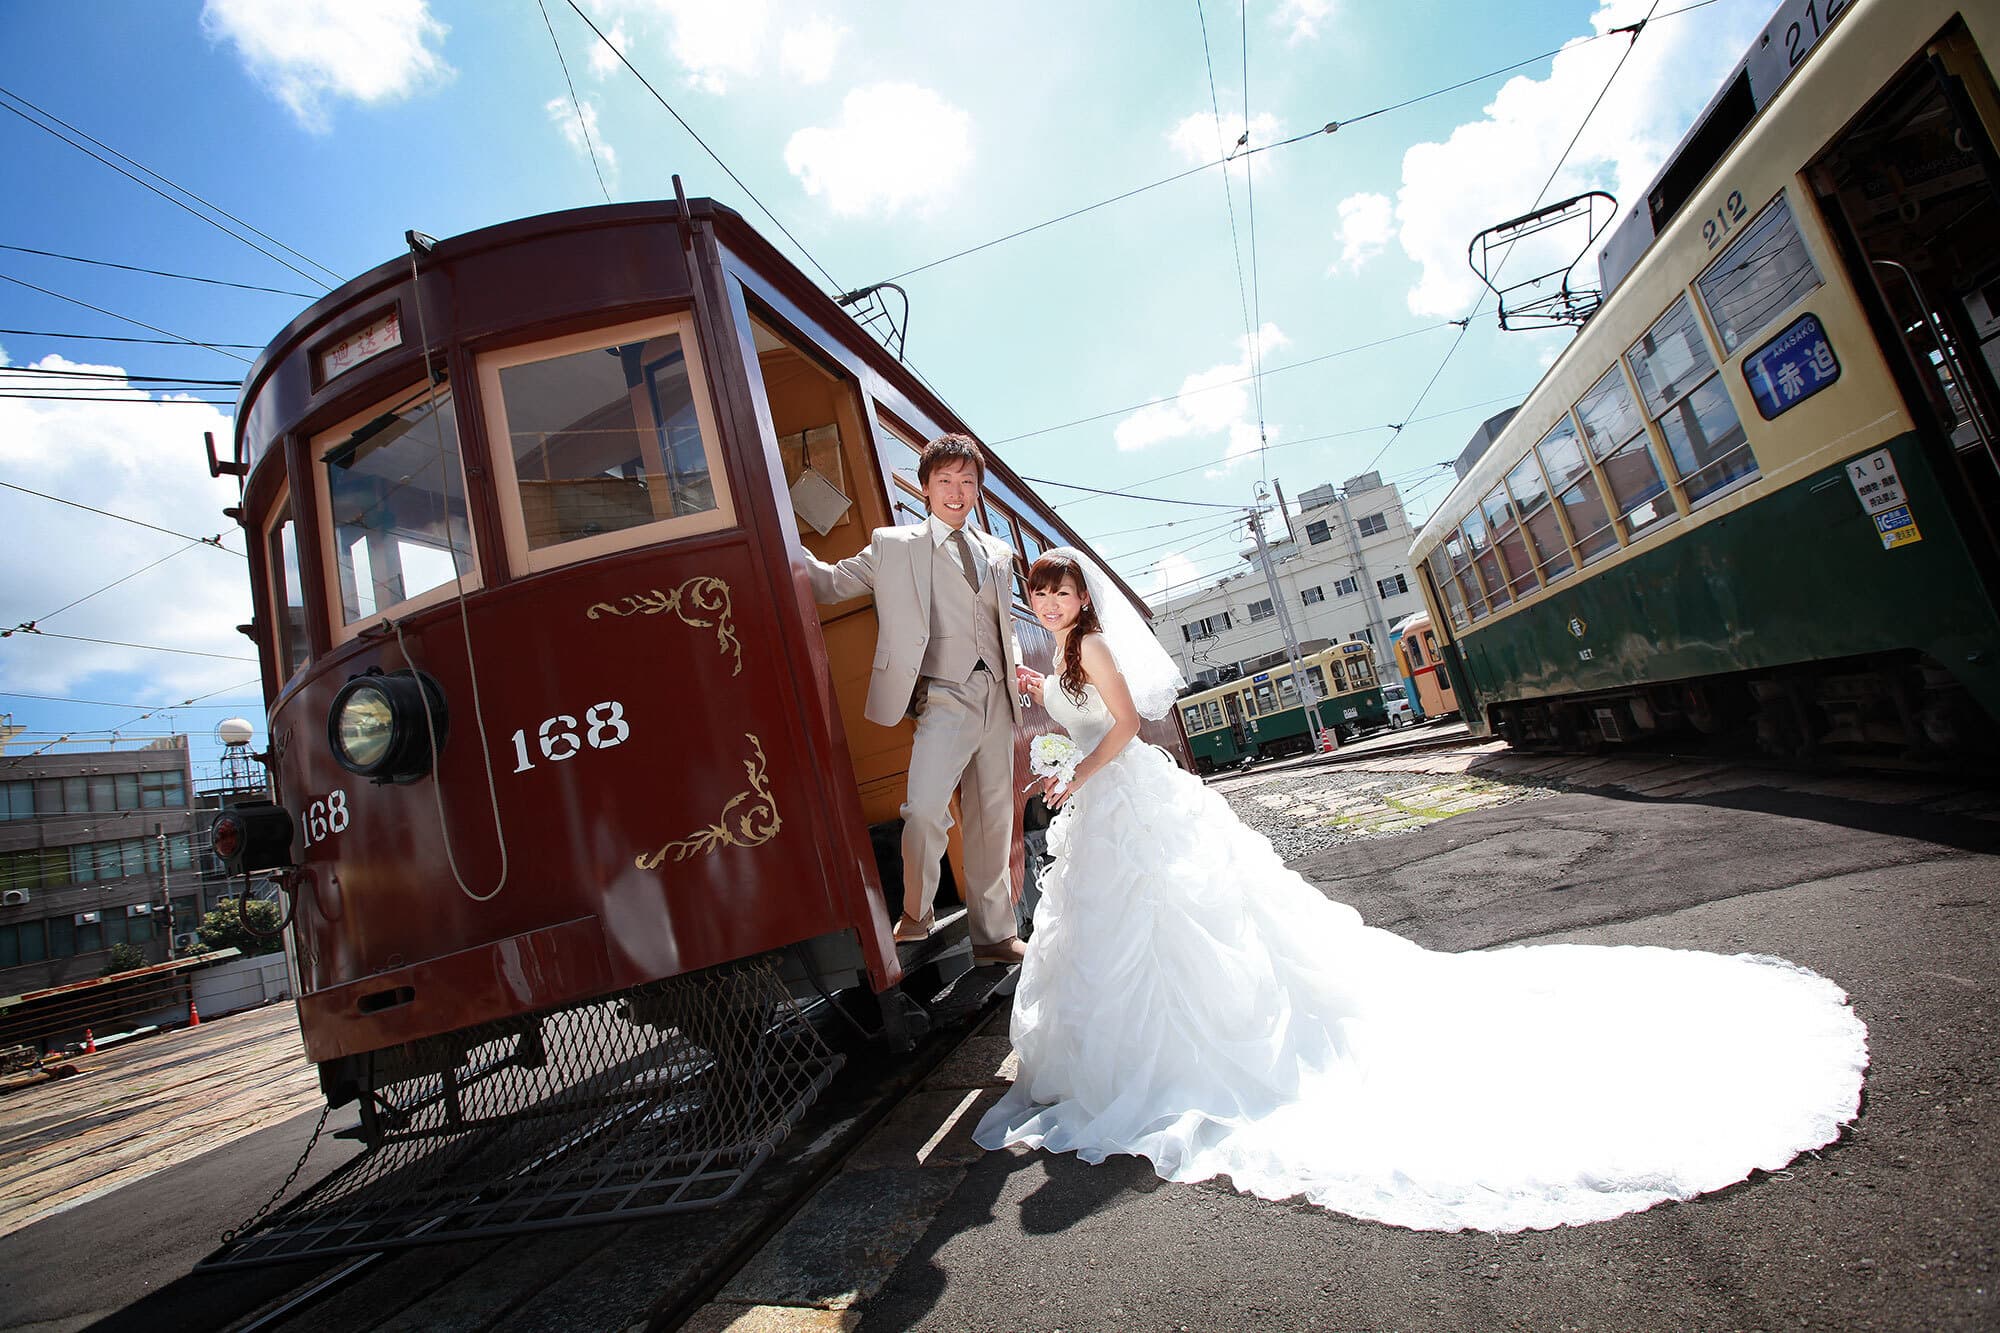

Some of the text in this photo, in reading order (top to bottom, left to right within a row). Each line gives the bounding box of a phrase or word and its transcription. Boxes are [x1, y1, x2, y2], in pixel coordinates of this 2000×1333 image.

[1703, 190, 1747, 250] 212
[1773, 322, 1816, 358] AKASAKO
[1756, 340, 1837, 408] 1 赤迫
[511, 700, 630, 774] 168
[301, 788, 350, 849] 168
